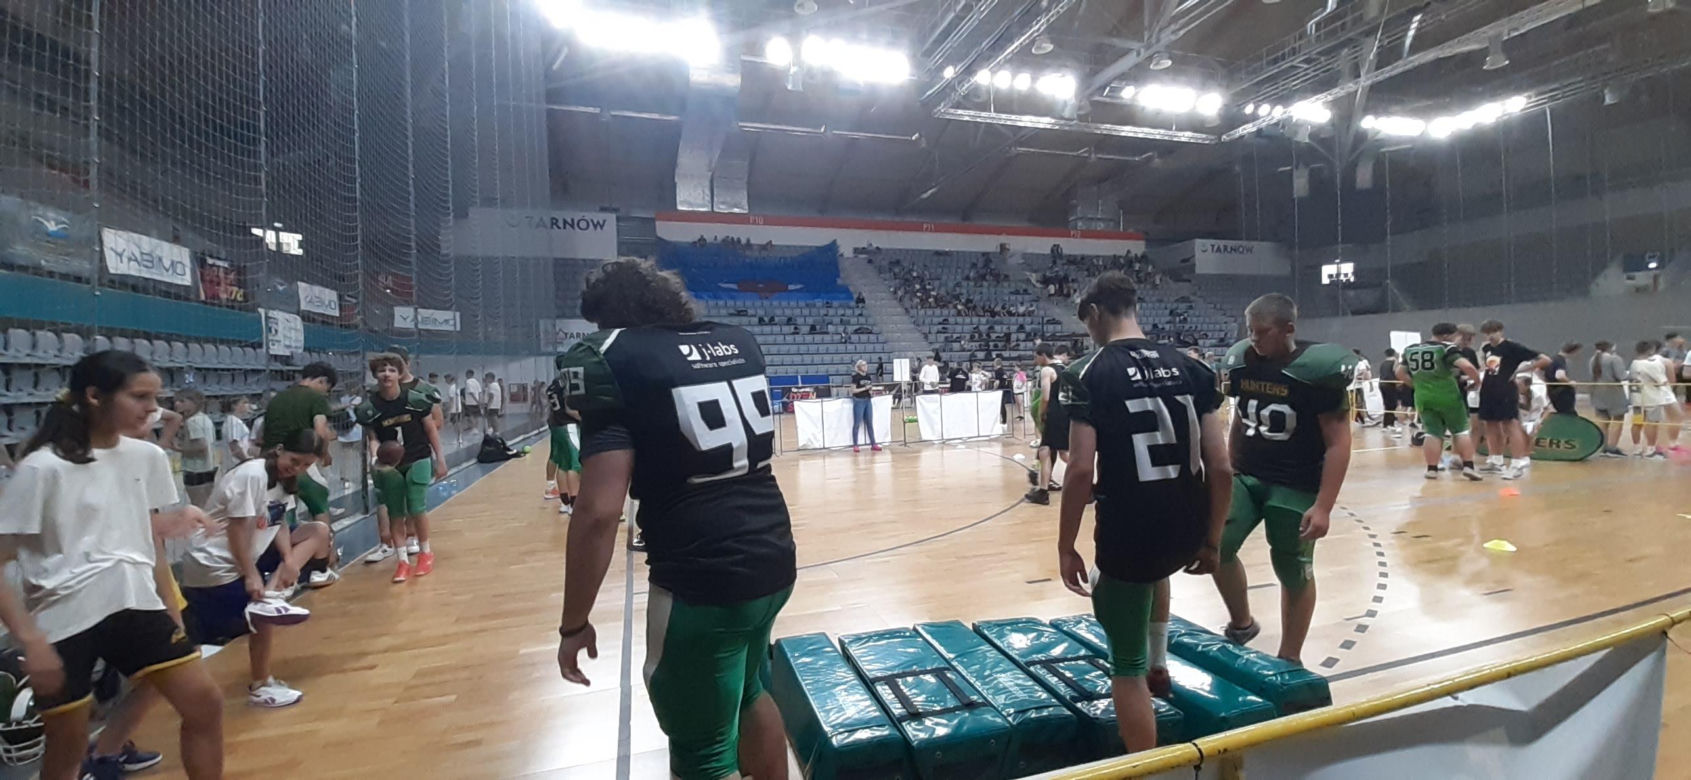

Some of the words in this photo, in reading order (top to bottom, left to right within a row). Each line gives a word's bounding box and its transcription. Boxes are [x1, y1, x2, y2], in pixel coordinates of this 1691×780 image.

[110, 246, 186, 277] YABIMO
[1409, 351, 1435, 371] 58
[1240, 378, 1289, 396] HUNTERS
[671, 374, 774, 483] 99
[1234, 395, 1297, 441] 40
[1124, 394, 1202, 482] 21
